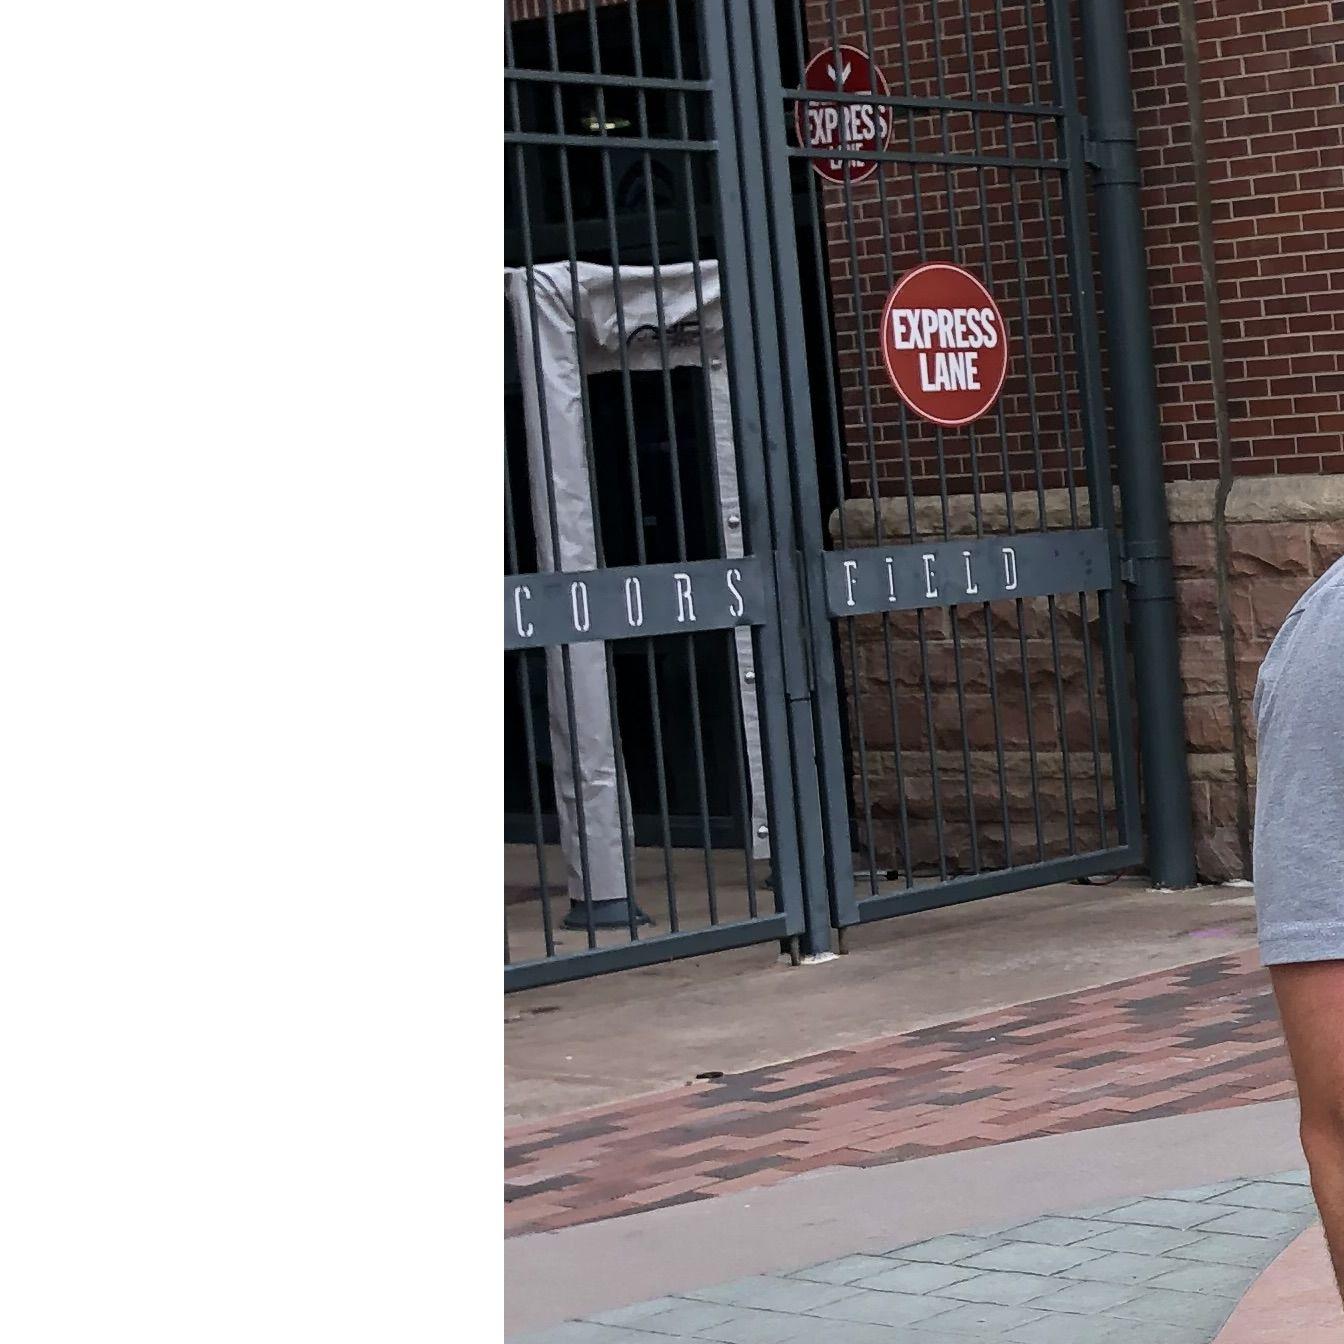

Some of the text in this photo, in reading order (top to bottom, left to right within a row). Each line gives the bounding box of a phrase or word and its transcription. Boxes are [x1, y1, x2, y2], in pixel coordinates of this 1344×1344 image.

[892, 307, 998, 350] EXPRESS
[919, 351, 981, 392] LANE
[514, 547, 1018, 638] COORS FIELD
